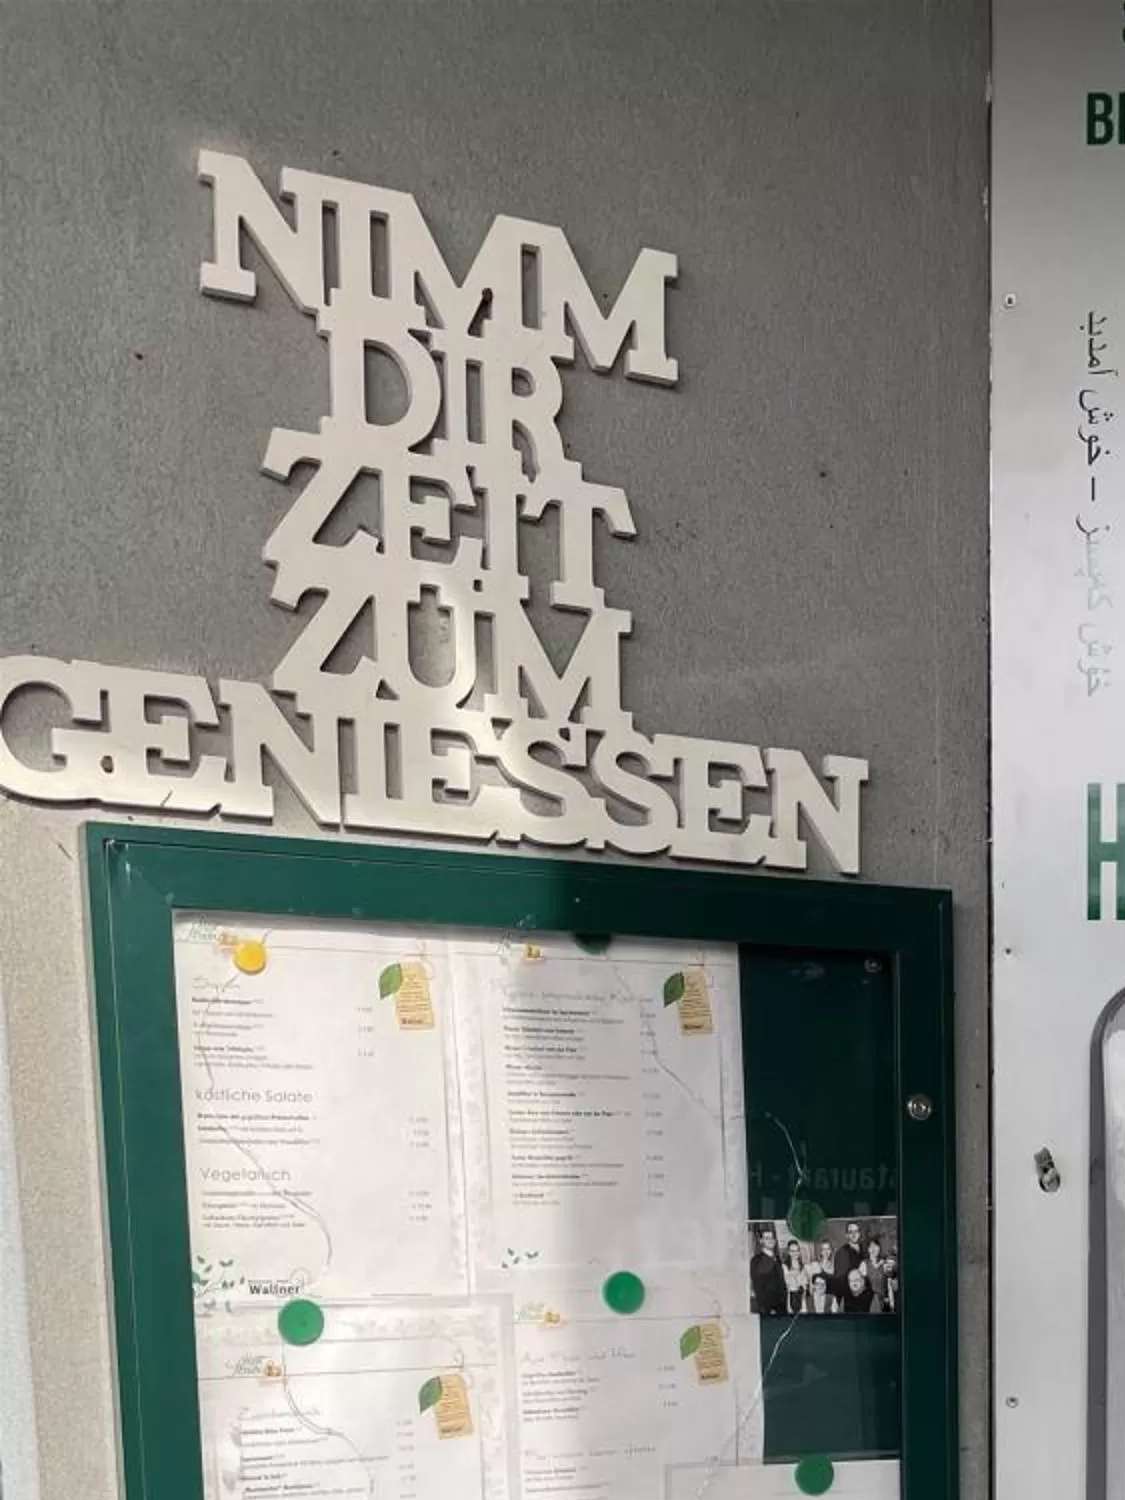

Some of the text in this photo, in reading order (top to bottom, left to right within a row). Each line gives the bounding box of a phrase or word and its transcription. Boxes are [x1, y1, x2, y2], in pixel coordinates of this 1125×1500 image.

[200, 149, 680, 386] NIMM
[317, 296, 583, 484] DIR
[260, 426, 637, 609] ZEIT
[0, 654, 869, 875] GENIESSEN
